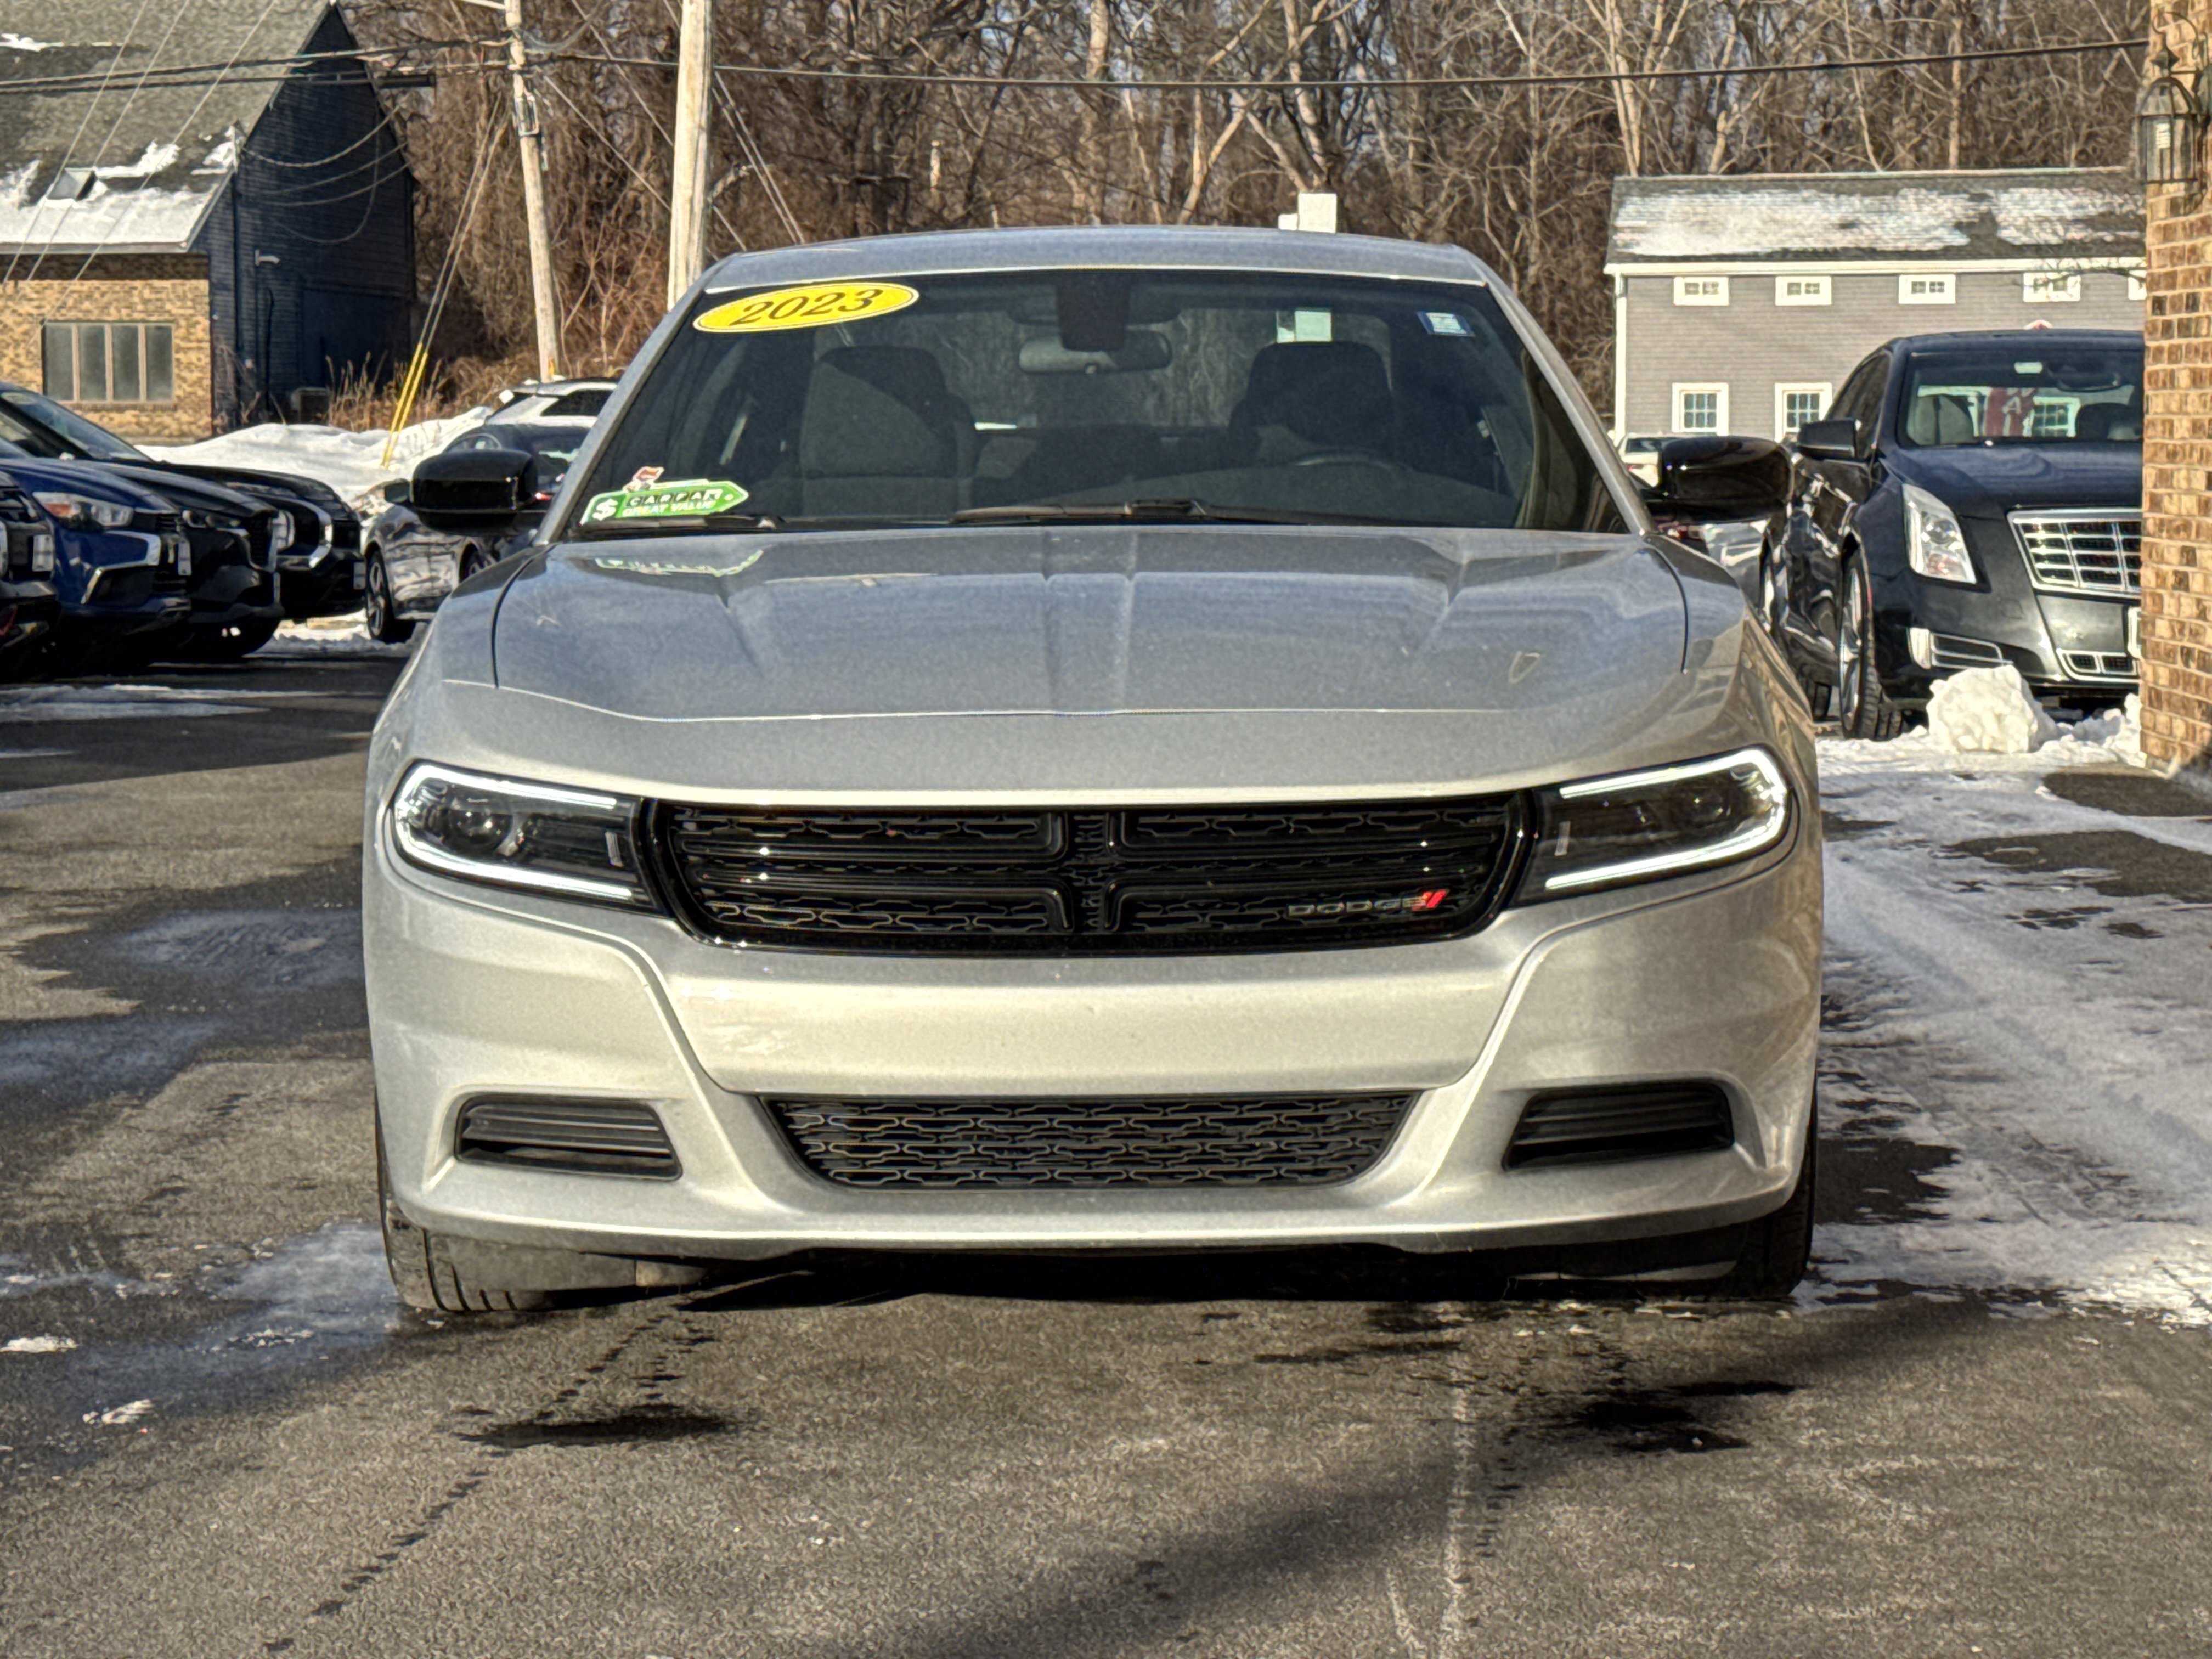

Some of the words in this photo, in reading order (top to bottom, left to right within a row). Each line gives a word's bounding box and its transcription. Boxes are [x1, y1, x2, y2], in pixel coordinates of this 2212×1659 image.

[728, 288, 884, 326] 2023
[592, 498, 619, 521] $
[622, 502, 669, 517] GREAT
[670, 500, 716, 512] VALUE
[1288, 896, 1426, 918] DODGE
